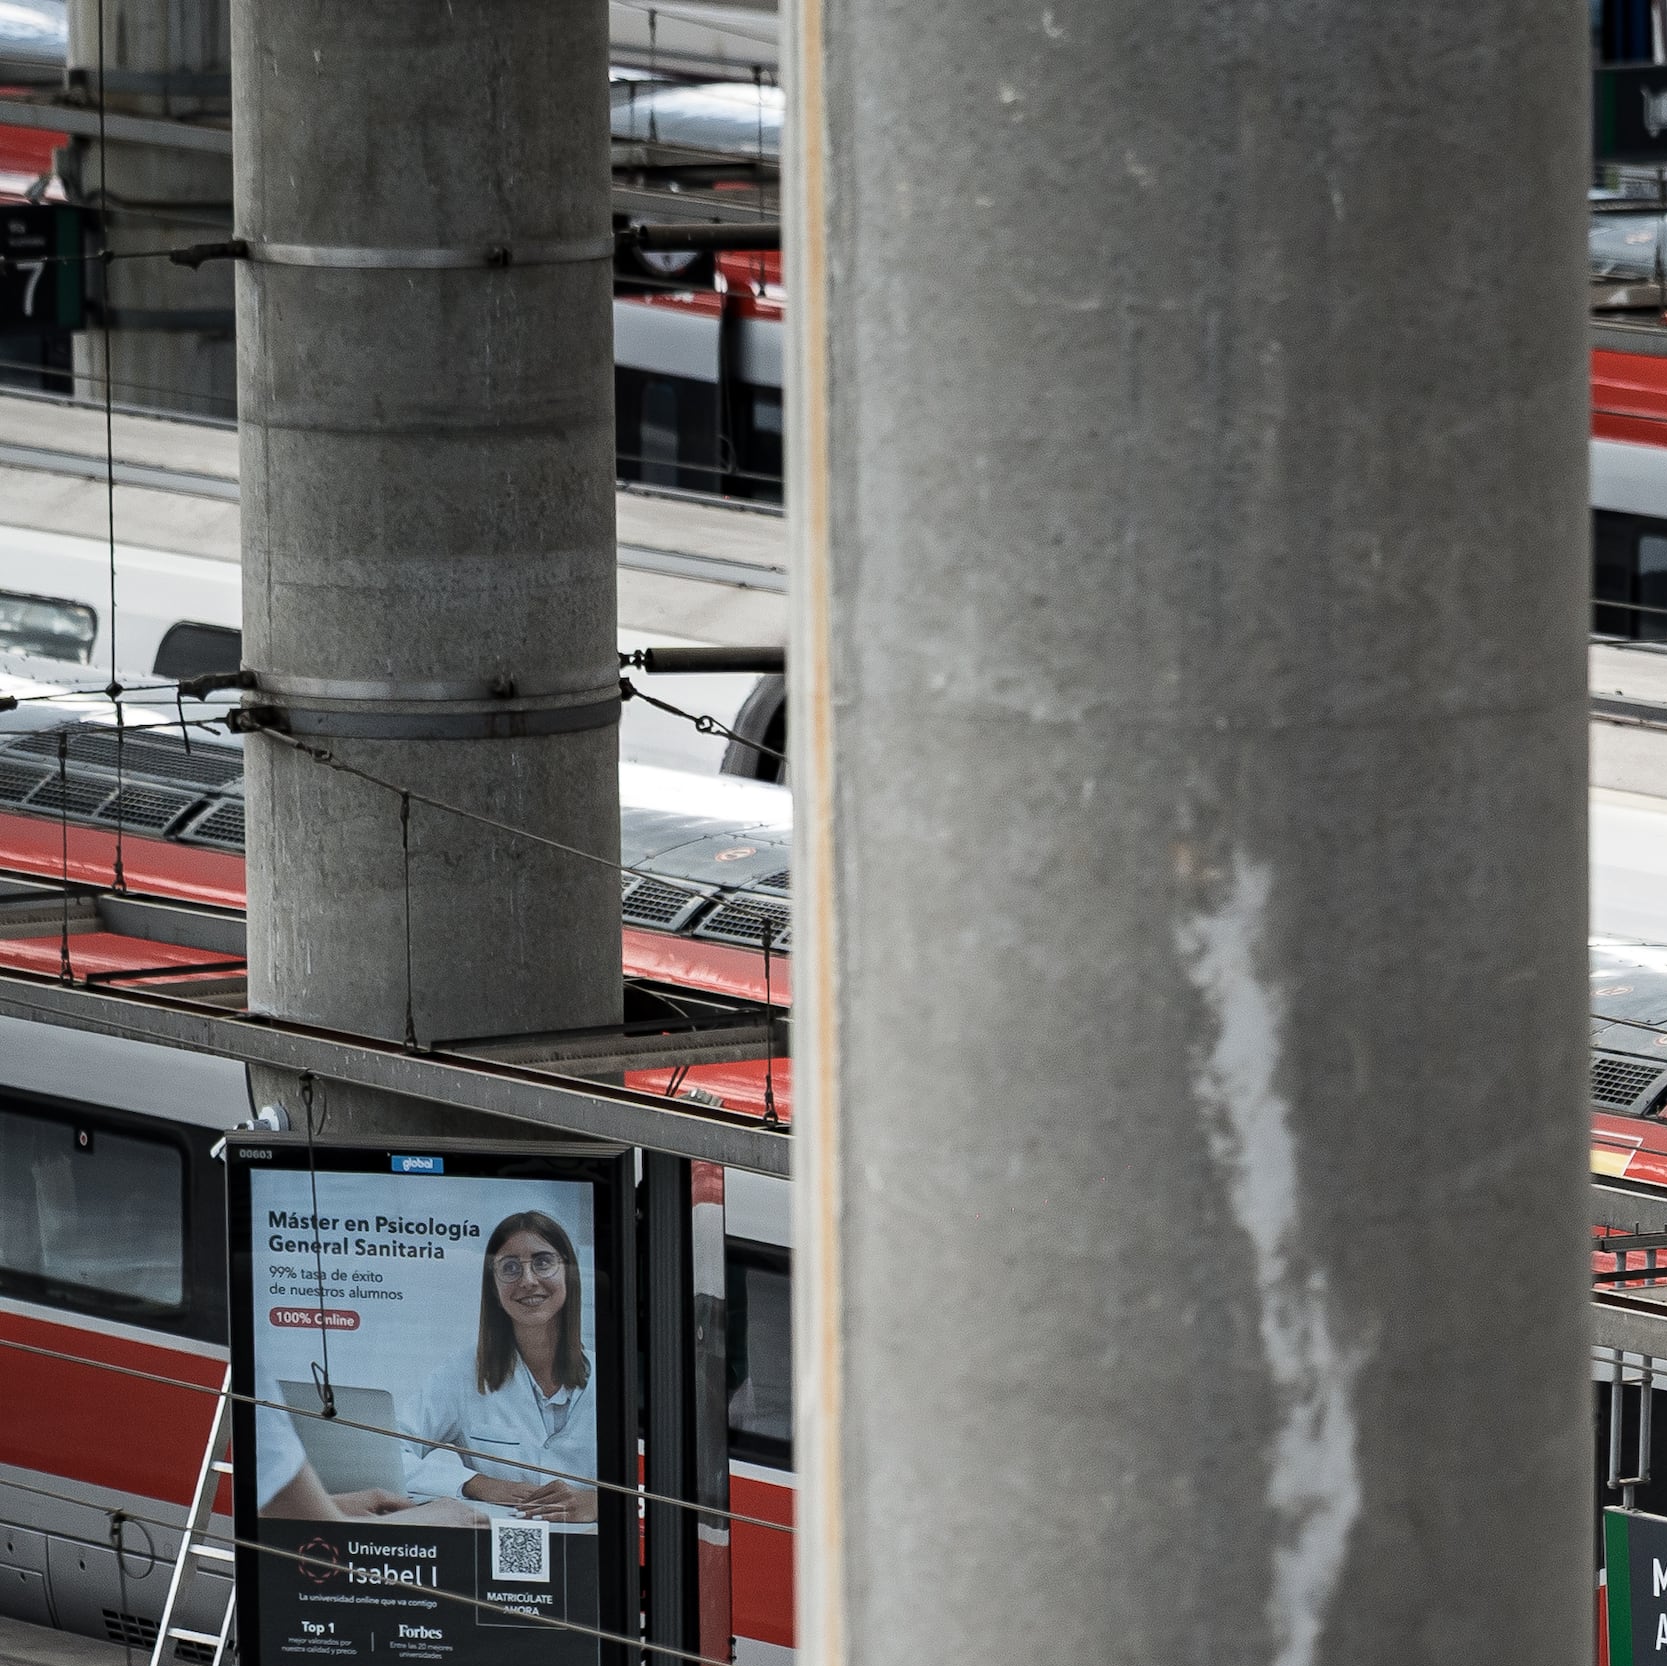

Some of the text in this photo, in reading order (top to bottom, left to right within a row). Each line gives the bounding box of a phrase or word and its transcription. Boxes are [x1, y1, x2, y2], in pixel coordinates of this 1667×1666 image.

[16, 261, 44, 317] 7
[402, 1157, 433, 1171] global
[268, 1210, 480, 1241] Máster en Psicología
[268, 1235, 445, 1259] General Sanitaria
[269, 1266, 384, 1283] 99% tasa de éxito
[269, 1283, 404, 1301] de nuestros alumnos
[275, 1312, 312, 1325] 100%
[348, 1541, 437, 1558] Universidad
[348, 1561, 422, 1587] Isabel
[299, 1592, 308, 1601] La
[309, 1593, 354, 1603] universidad
[356, 1596, 379, 1604] online
[381, 1598, 396, 1607] que
[408, 1599, 437, 1610] contigo
[301, 1621, 335, 1636] Top 1
[398, 1624, 443, 1640] Forbes
